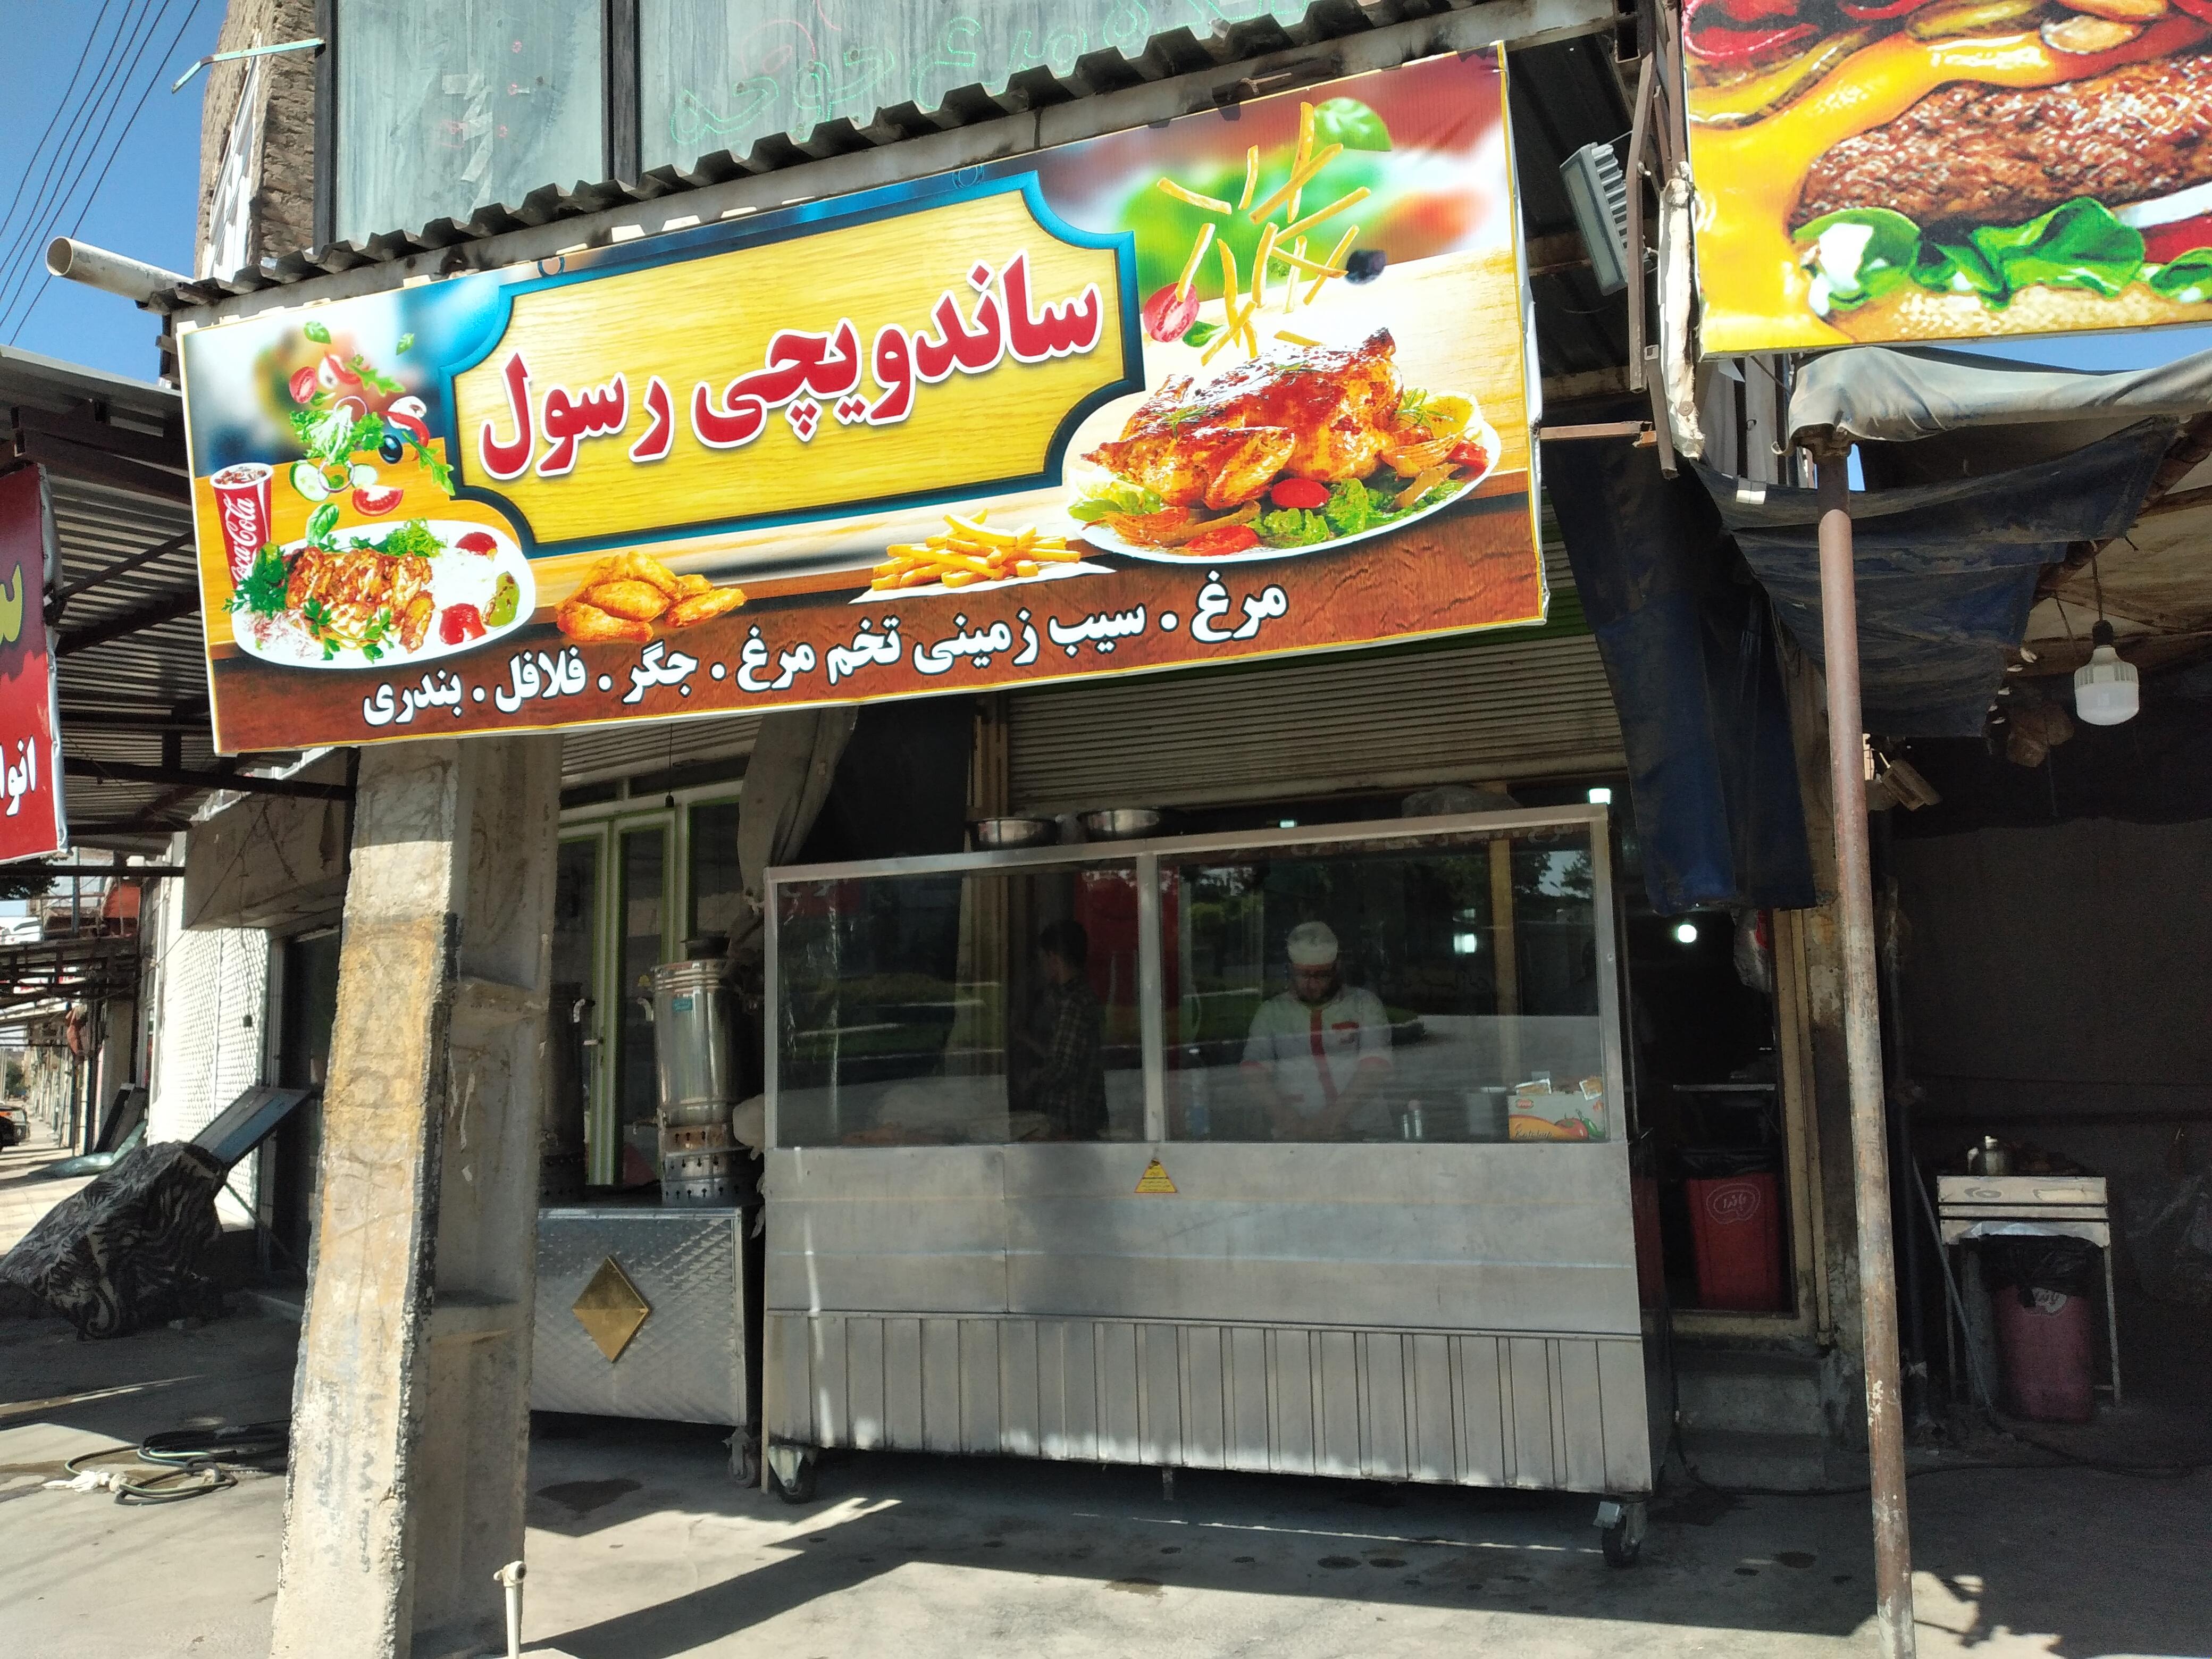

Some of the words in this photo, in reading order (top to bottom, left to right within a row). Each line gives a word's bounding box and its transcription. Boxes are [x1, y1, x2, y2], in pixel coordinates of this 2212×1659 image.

[693, 251, 1101, 446] ساندویچی
[481, 353, 673, 479] رسول
[1049, 605, 1145, 656] سیب
[1191, 570, 1287, 642] مرغ
[623, 641, 698, 703] جگر
[736, 626, 816, 691] مرغ
[826, 617, 901, 684] تخم
[914, 609, 1038, 674] زمینی
[363, 669, 462, 726] بندری
[495, 647, 586, 713] فلافل
